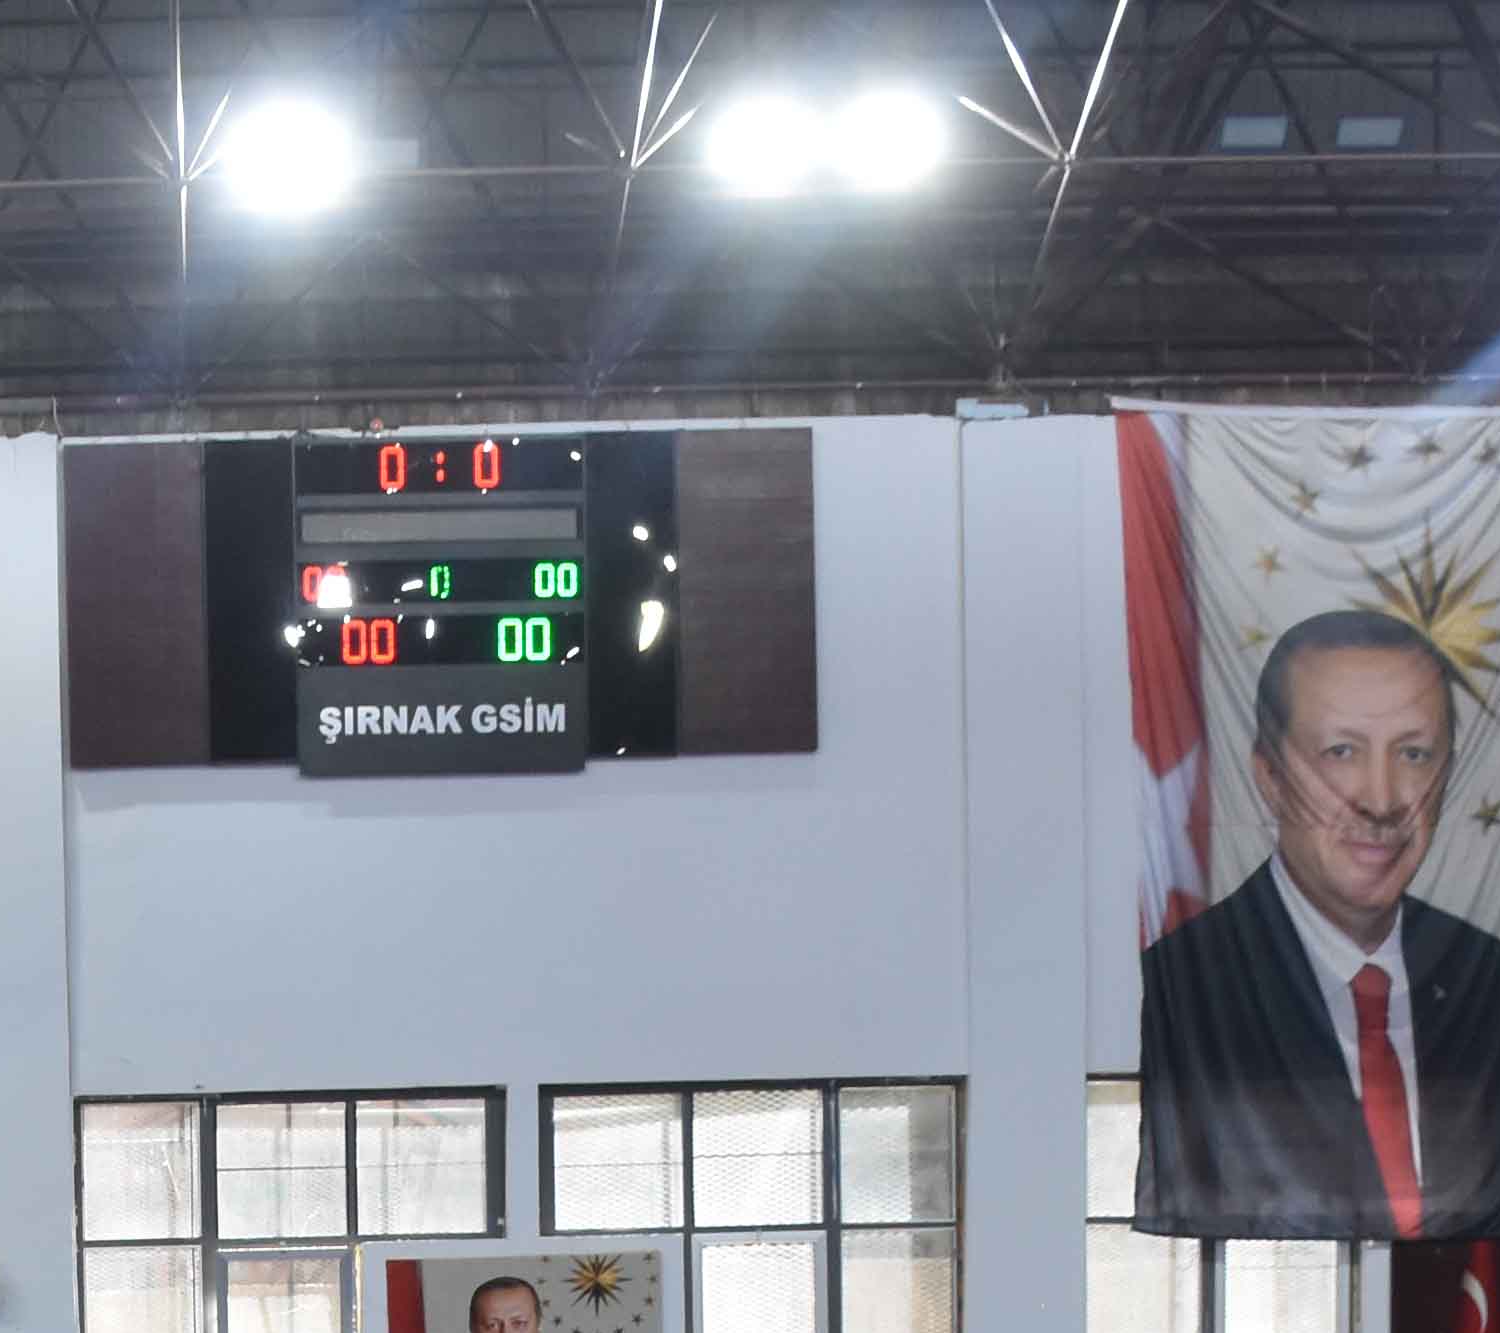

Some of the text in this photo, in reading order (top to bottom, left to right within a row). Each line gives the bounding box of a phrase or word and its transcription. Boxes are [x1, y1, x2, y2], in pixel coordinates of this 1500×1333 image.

[534, 562, 578, 598] 00
[342, 618, 396, 665] 00
[498, 617, 551, 661] 00
[319, 697, 566, 745] ŞIRNAK GSİM
